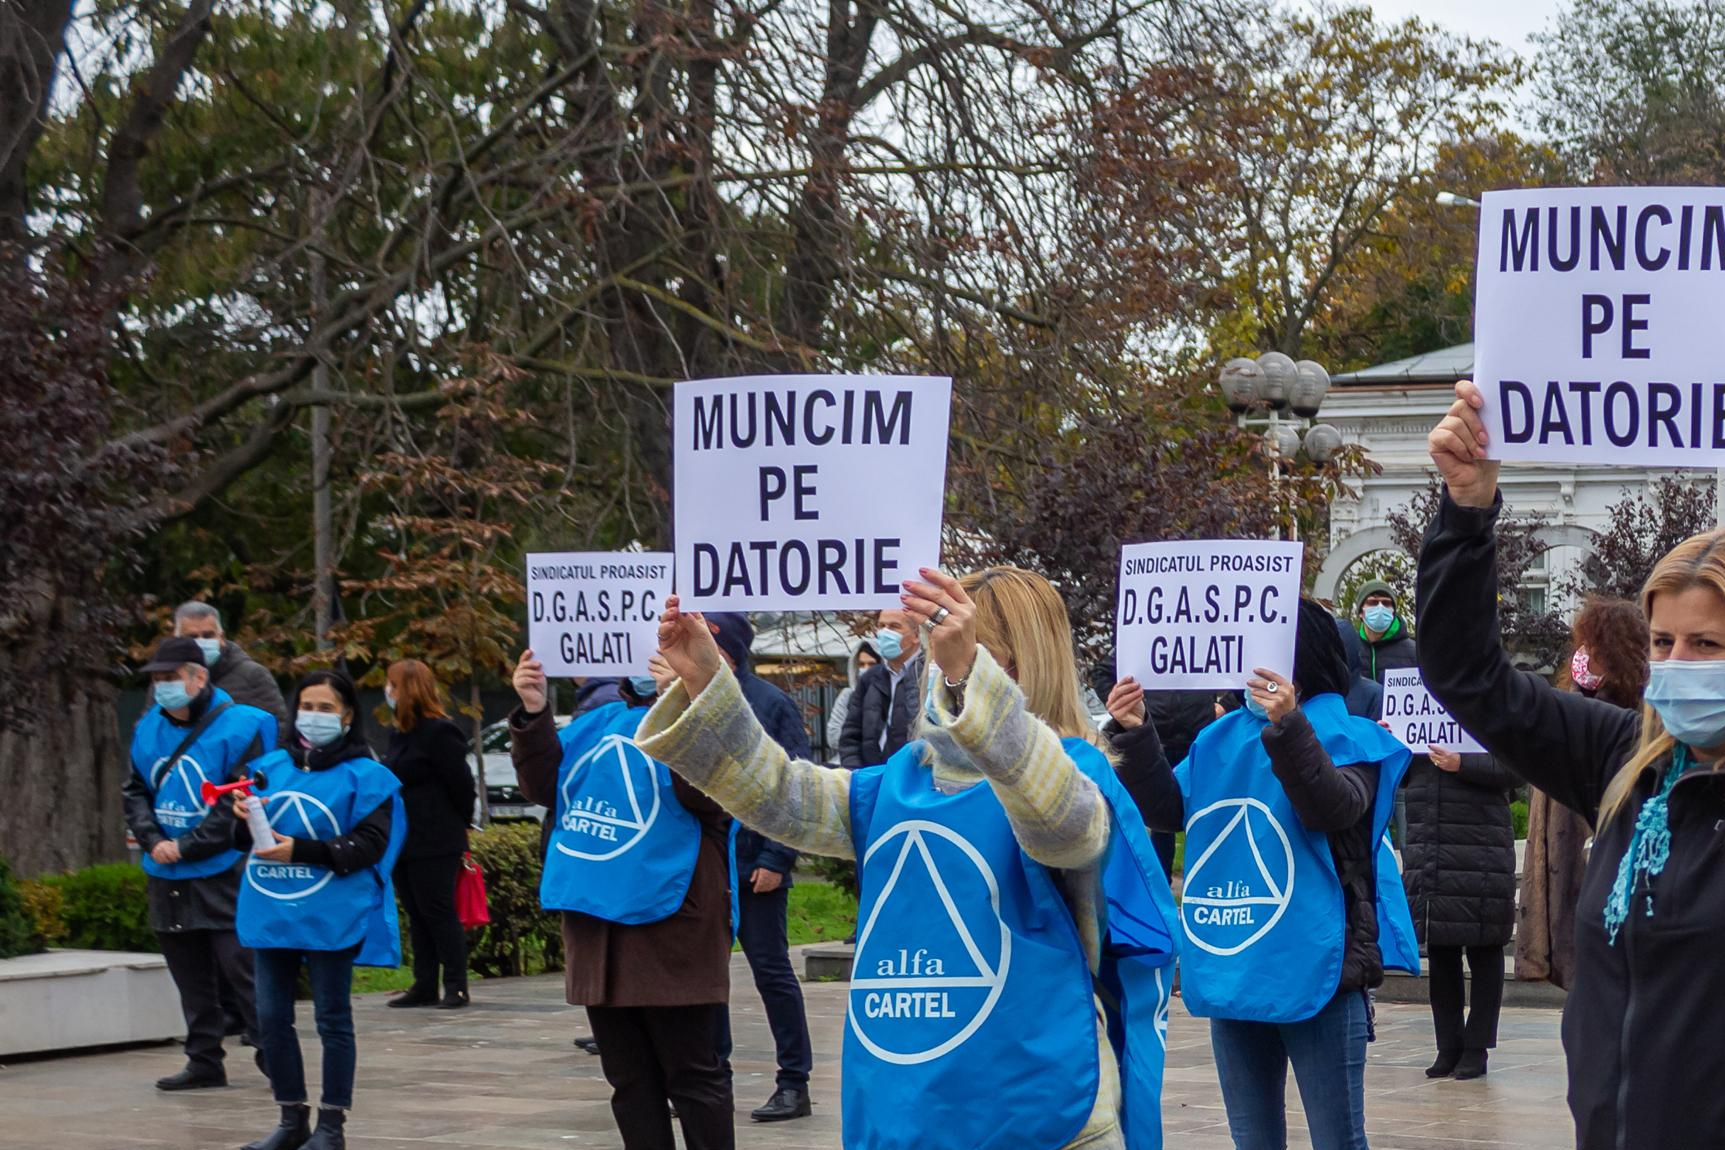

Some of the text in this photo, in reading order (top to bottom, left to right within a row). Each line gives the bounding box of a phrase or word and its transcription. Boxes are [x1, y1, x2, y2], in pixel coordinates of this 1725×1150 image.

[1581, 293, 1651, 359] PE
[693, 389, 913, 451] MUNCIM
[759, 464, 820, 521] PE
[531, 565, 667, 580] SINDICATUL PROASIST
[693, 538, 901, 597] DATORIE
[1125, 555, 1294, 576] SINDICATUL PROASIST
[533, 590, 661, 622] D.G.A.S.P.C.
[1123, 584, 1288, 626] D.G.A.S.P.C.
[560, 632, 633, 664] GALATI
[1151, 635, 1244, 675] GALATI
[1387, 676, 1424, 688] SINDICA
[1406, 722, 1463, 745] GALATI
[572, 796, 617, 818] alfa
[256, 866, 314, 879] CARTEL
[1206, 879, 1250, 899] alfa
[1193, 905, 1255, 927] CARTEL
[877, 948, 945, 976] alfa
[864, 992, 956, 1019] CARTEL
